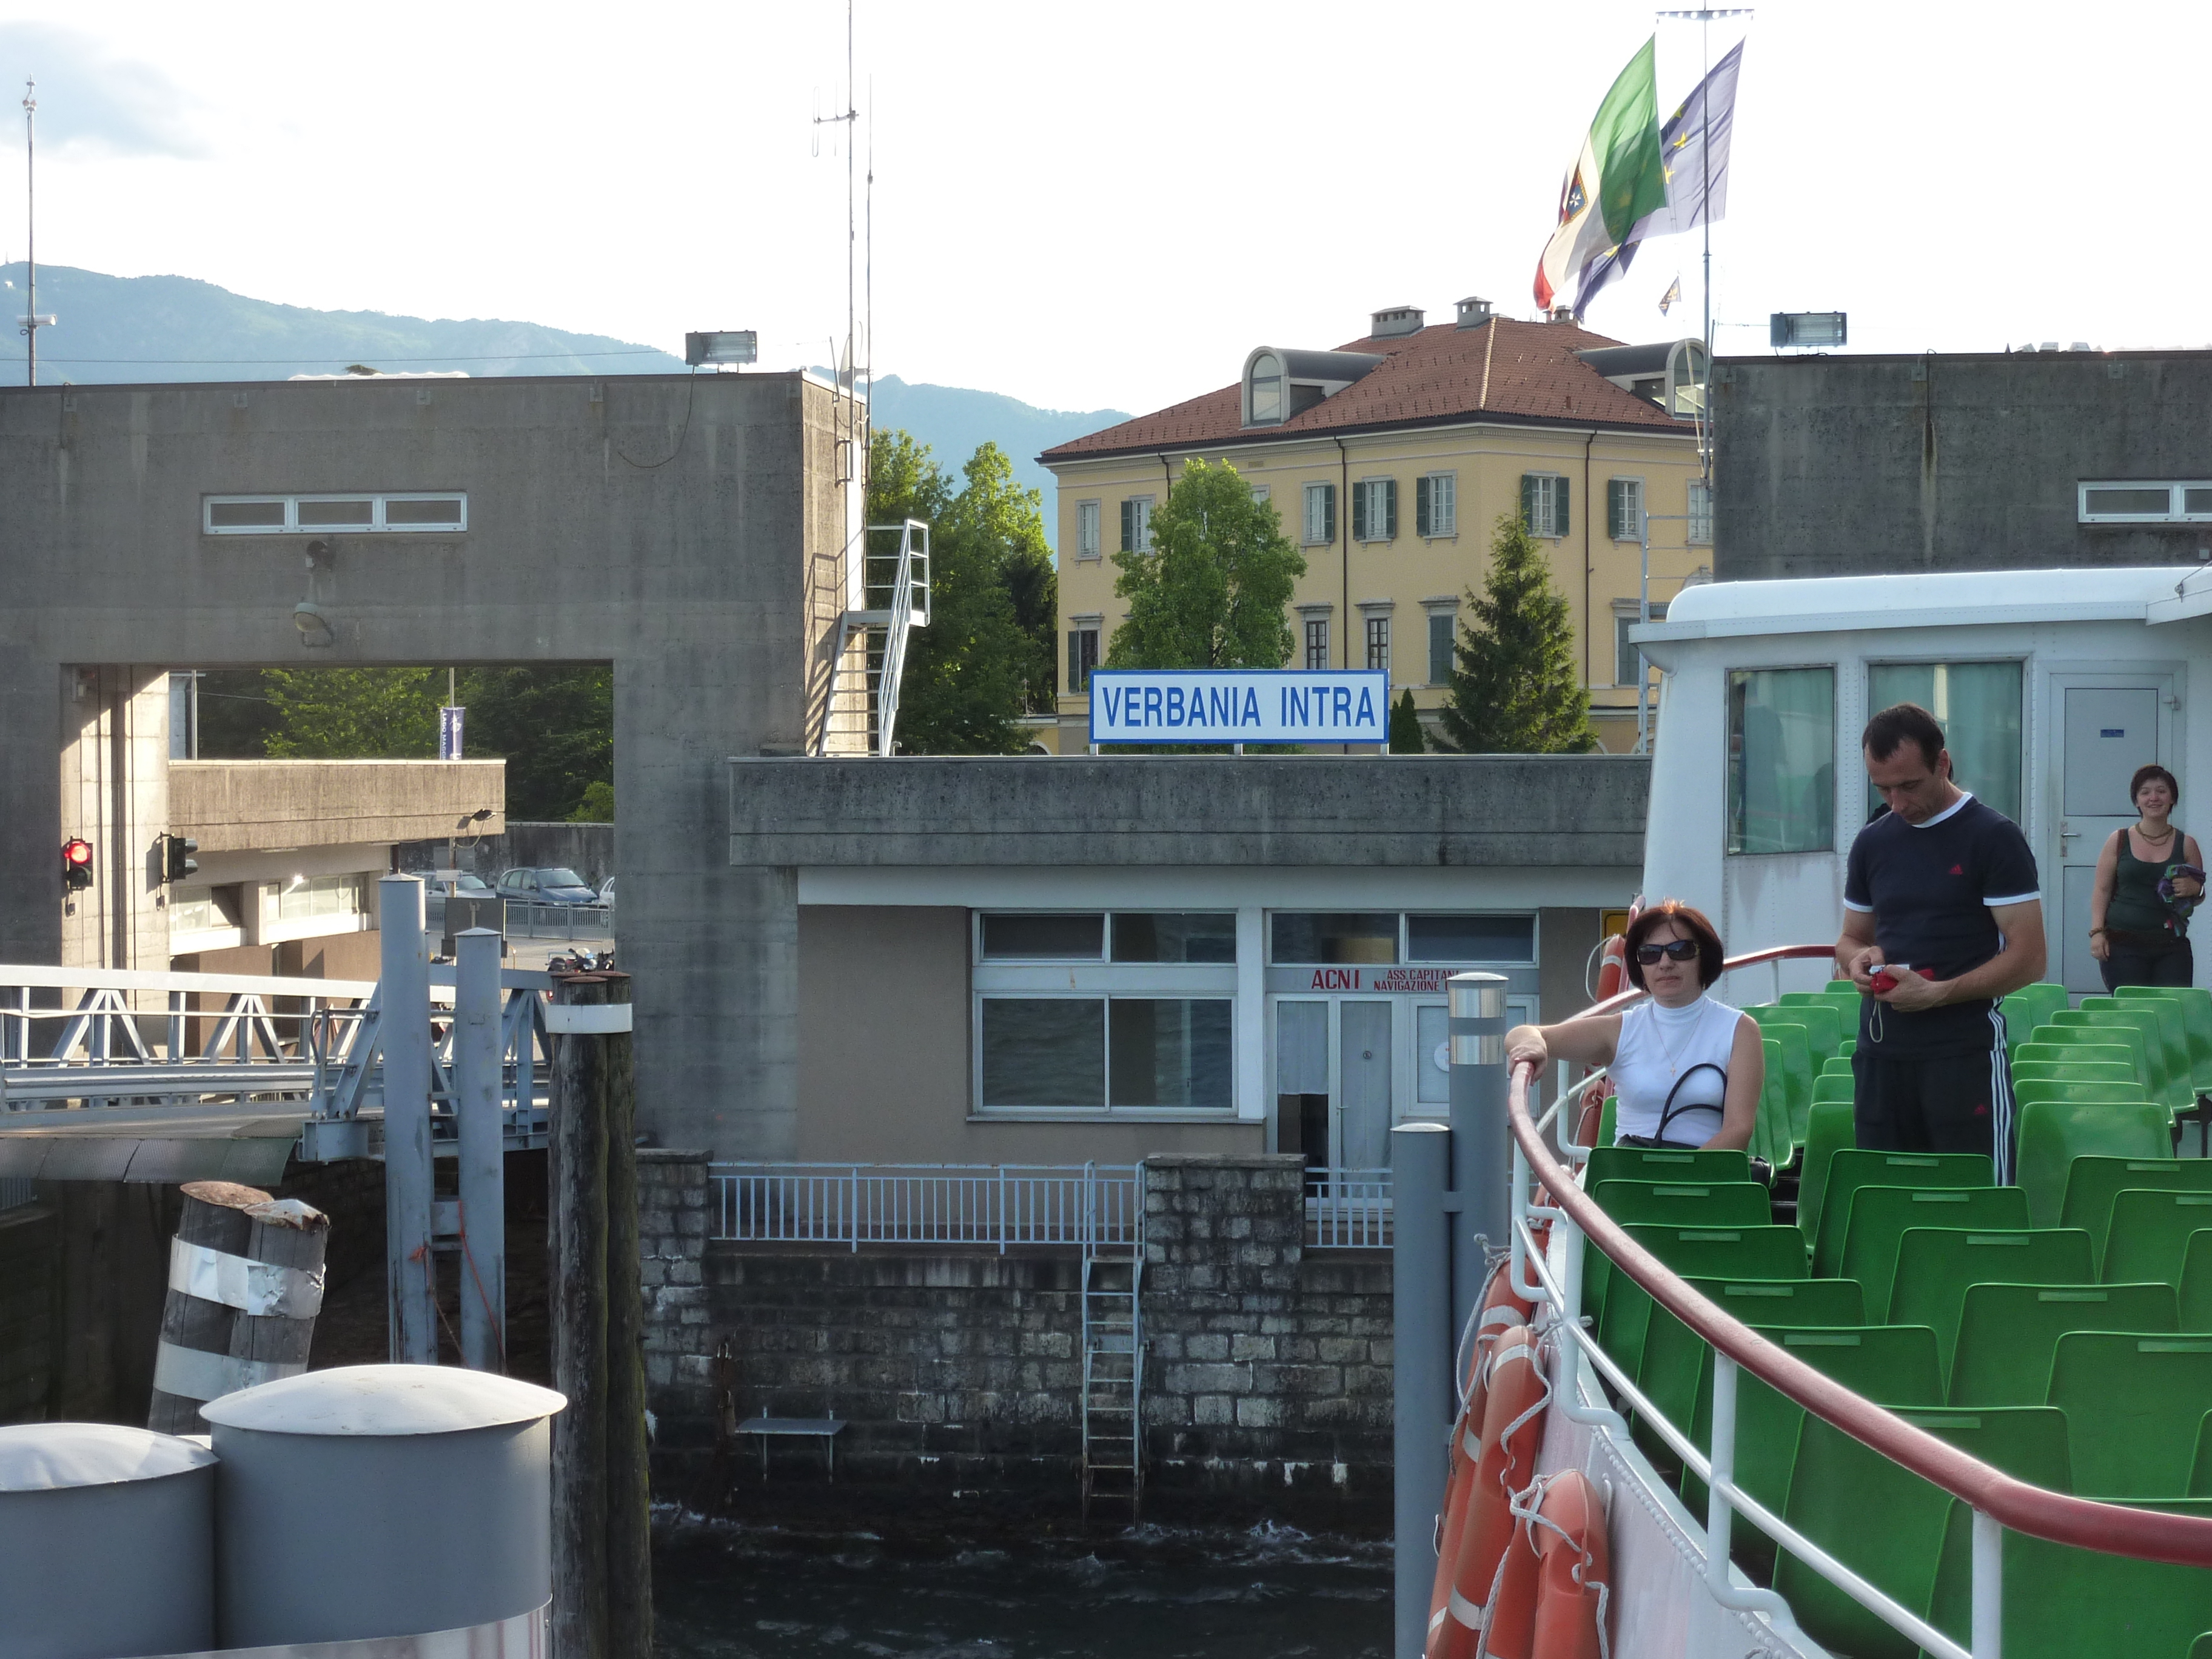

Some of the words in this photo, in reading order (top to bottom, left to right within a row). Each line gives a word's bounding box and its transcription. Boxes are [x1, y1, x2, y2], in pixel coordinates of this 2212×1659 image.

[1102, 686, 1261, 727] VERBANIA
[1281, 686, 1376, 727] INTRA
[1311, 969, 1359, 990] ACNI
[1373, 980, 1439, 991] NAVIGAZIONE
